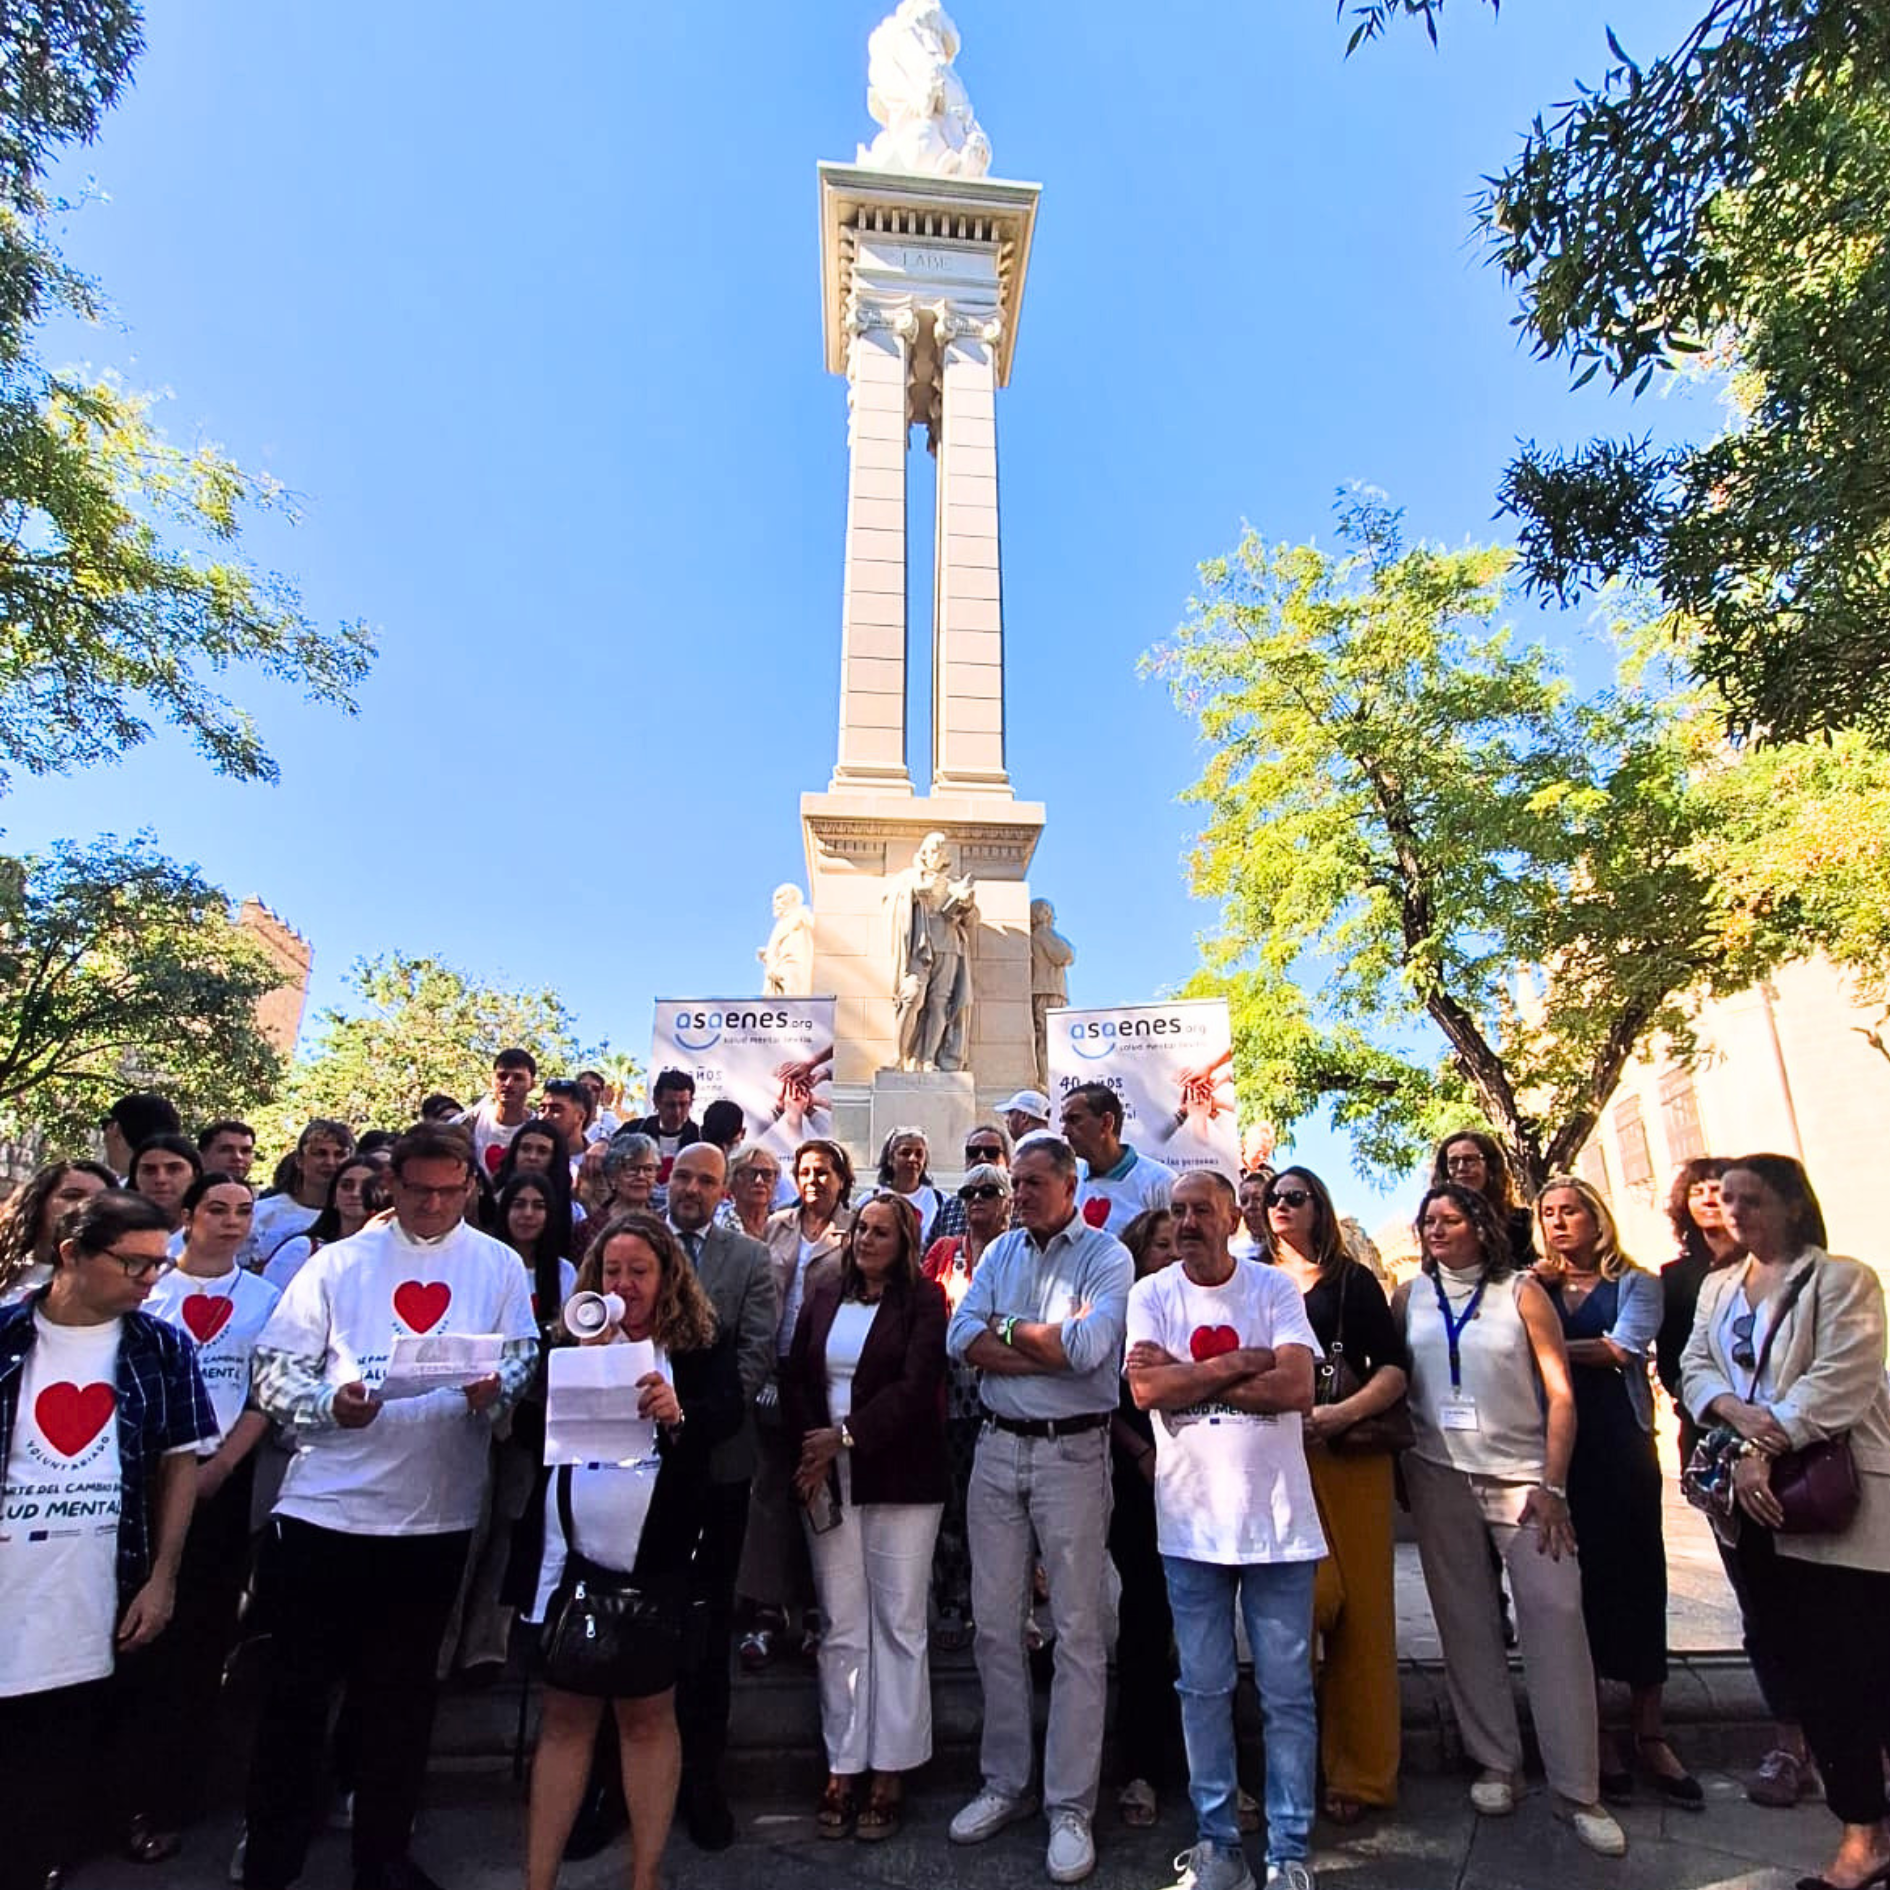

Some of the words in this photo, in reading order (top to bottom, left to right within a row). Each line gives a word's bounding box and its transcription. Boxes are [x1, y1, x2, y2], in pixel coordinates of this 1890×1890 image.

[27, 1436, 110, 1471] VOLUNTARIADO
[37, 1484, 60, 1495] DEL
[65, 1483, 112, 1493] CAMBIO
